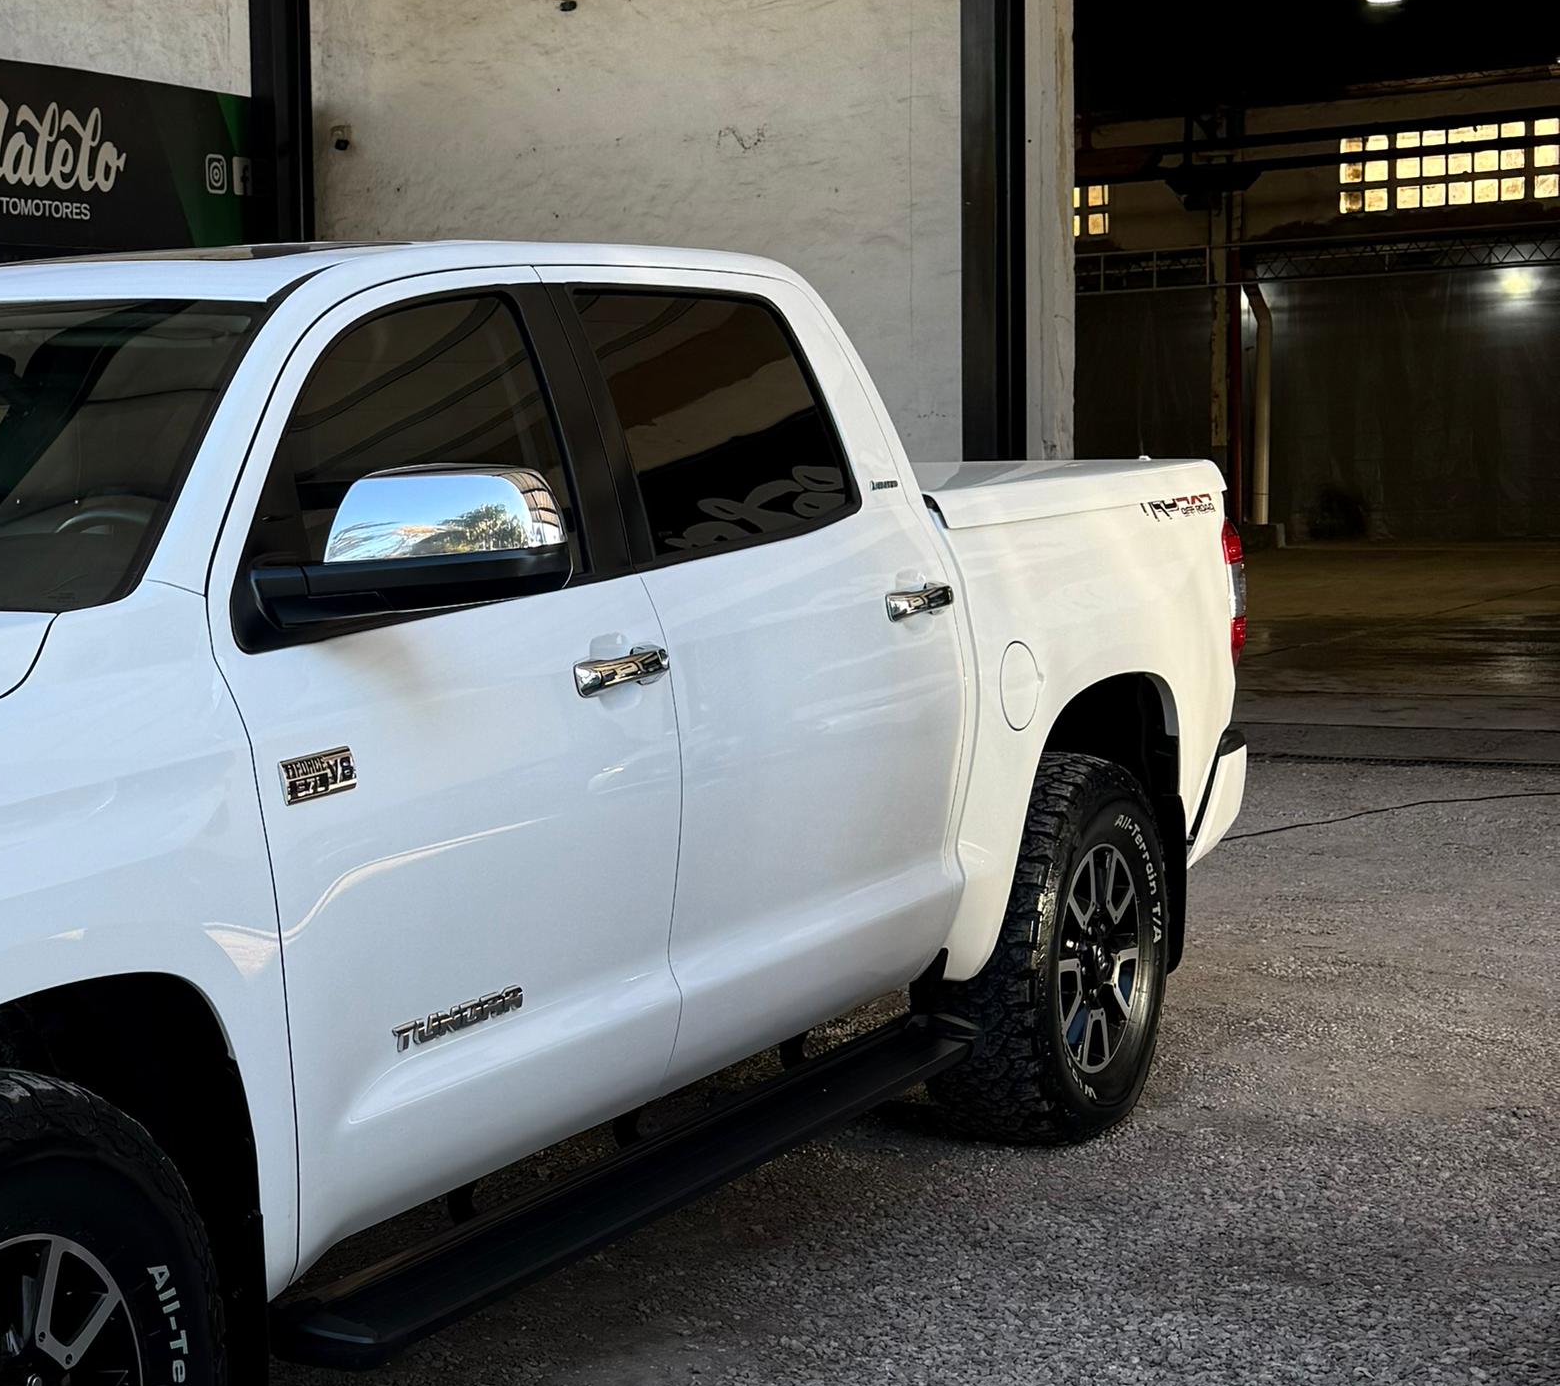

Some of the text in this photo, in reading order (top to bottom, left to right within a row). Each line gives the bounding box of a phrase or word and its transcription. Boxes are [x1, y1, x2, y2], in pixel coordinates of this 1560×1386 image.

[1114, 814, 1162, 943] All-Terrain T/A
[392, 984, 524, 1053] TUNDRA
